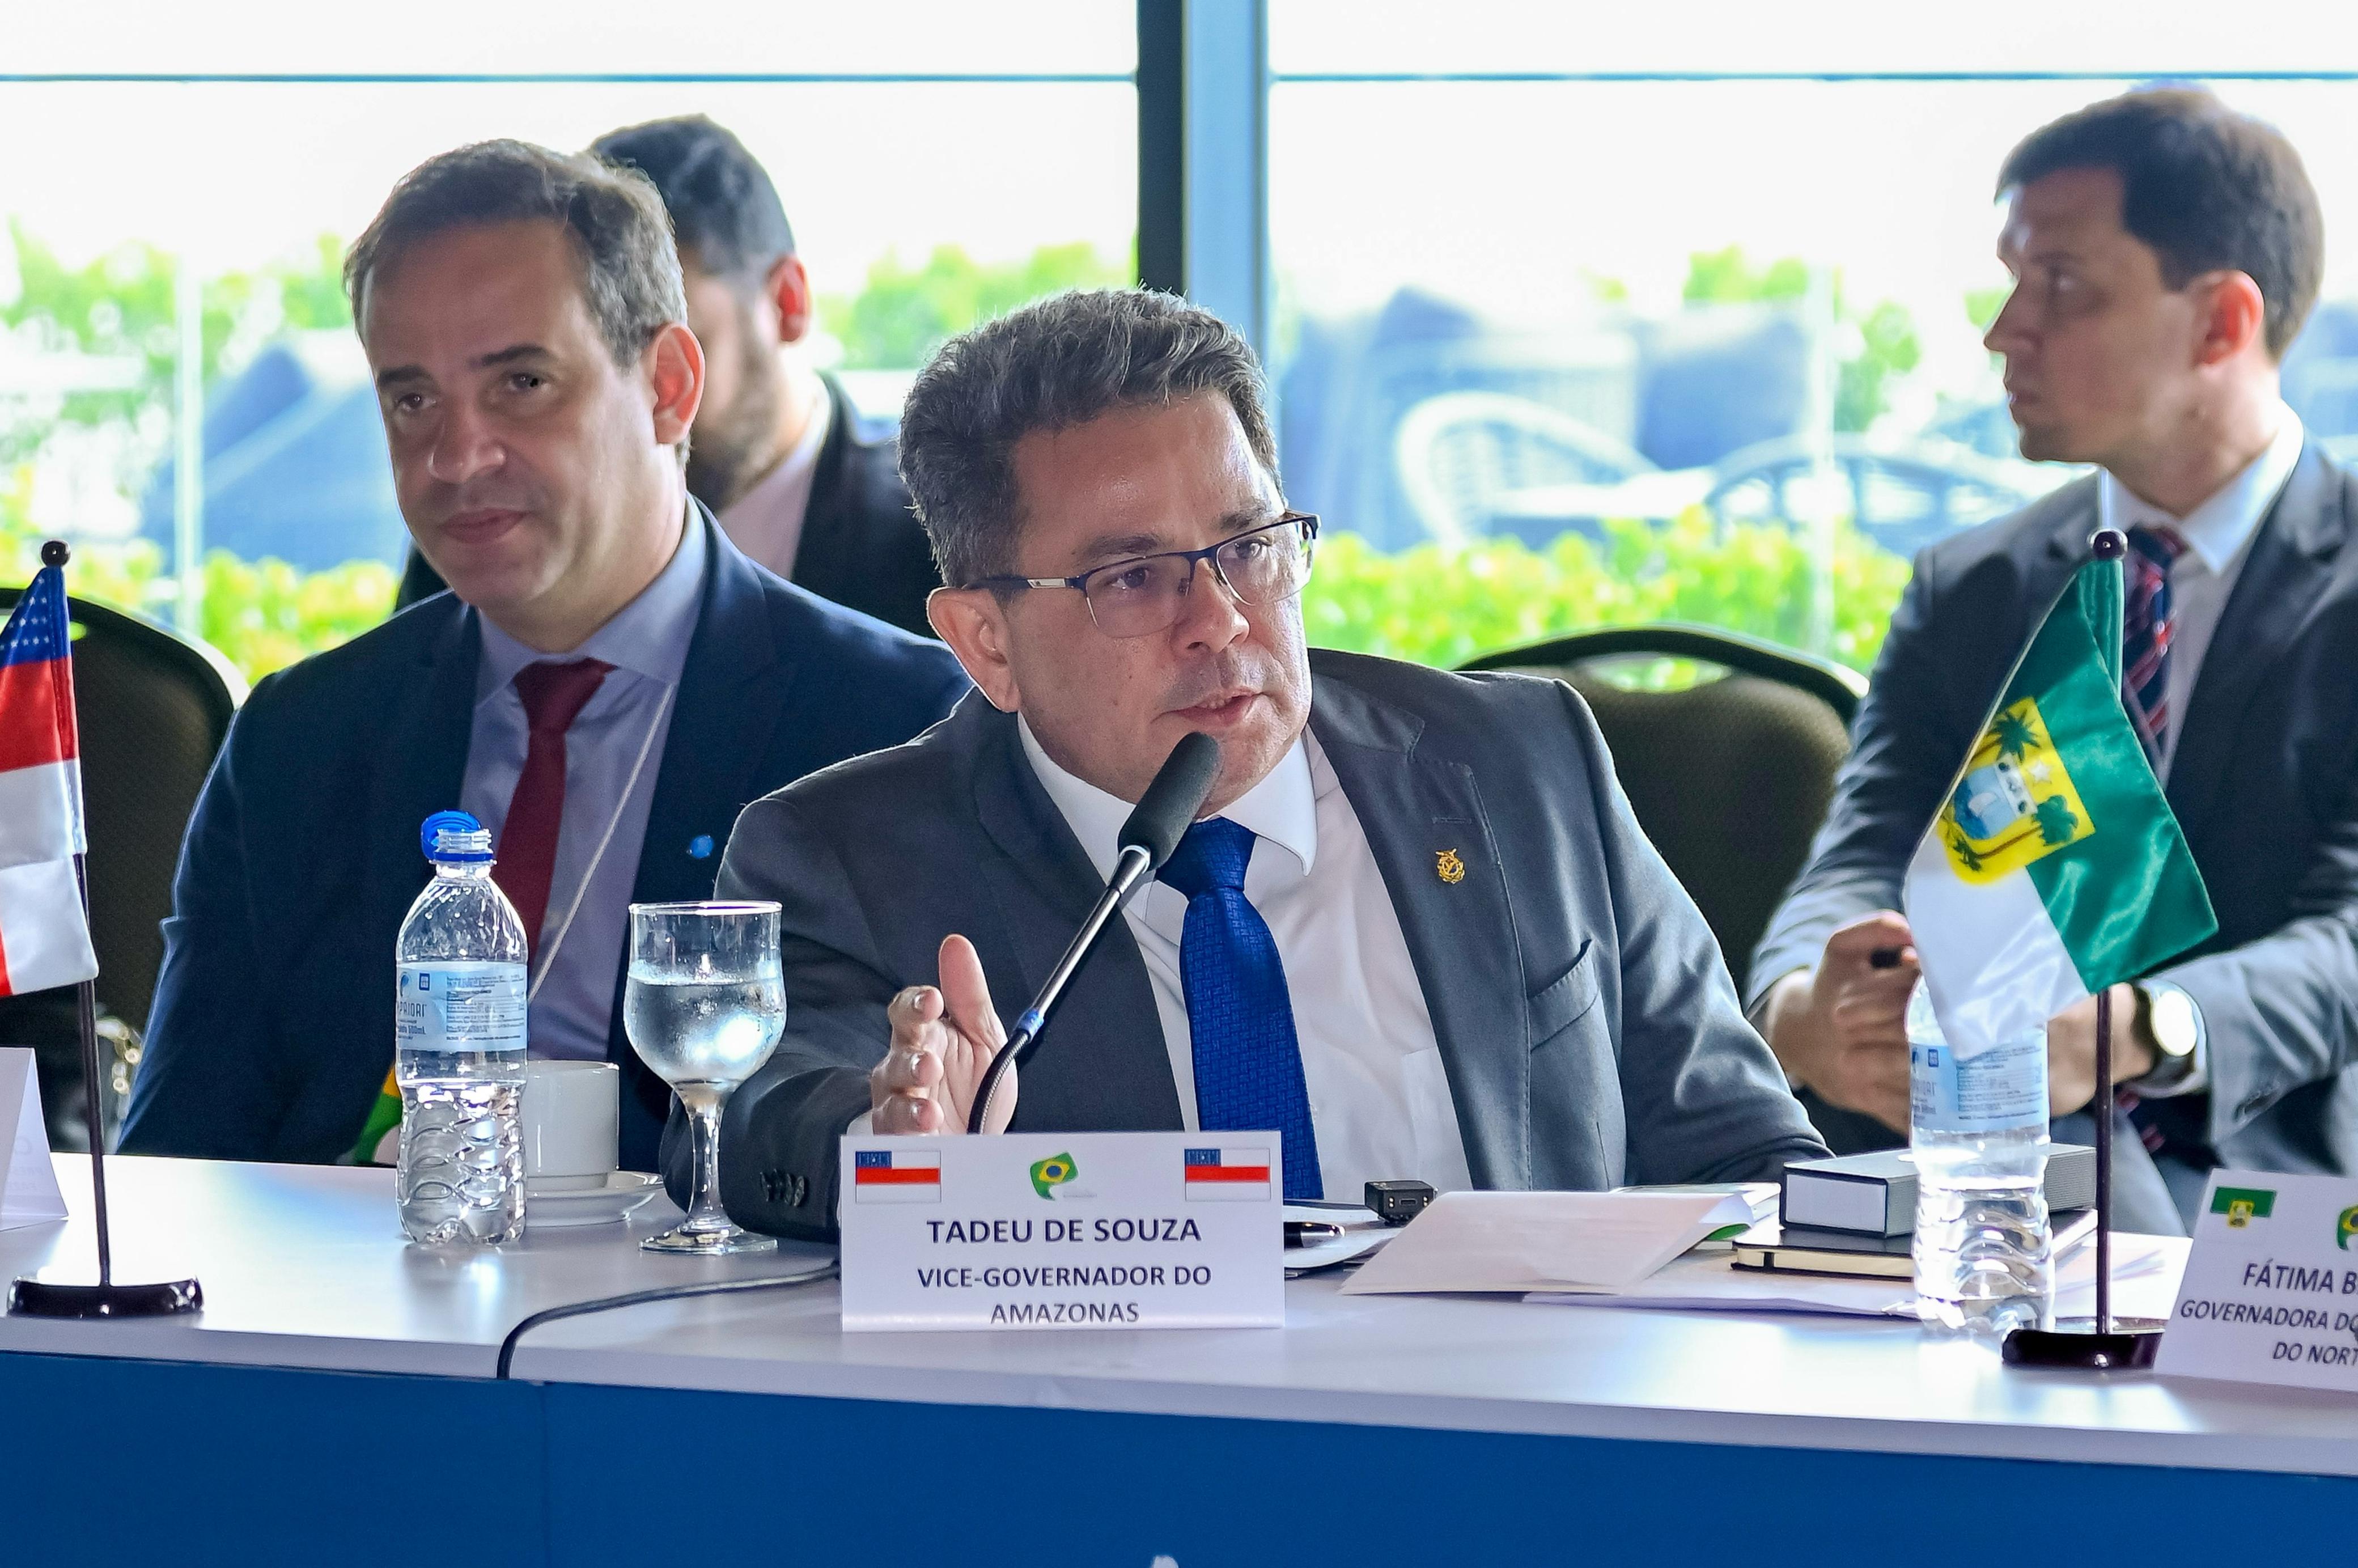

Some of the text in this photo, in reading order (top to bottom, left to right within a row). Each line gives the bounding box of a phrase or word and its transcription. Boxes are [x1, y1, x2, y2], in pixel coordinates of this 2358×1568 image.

[926, 1218, 1202, 1244] TADEU DE SOUZA
[917, 1265, 1212, 1289] VICE-GOVERNADOR DO
[2242, 1258, 2358, 1295] FÁTIMA B
[990, 1302, 1140, 1325] AMAZONAS
[2179, 1299, 2328, 1330] GOVERNADORA
[2272, 1341, 2304, 1362] DO
